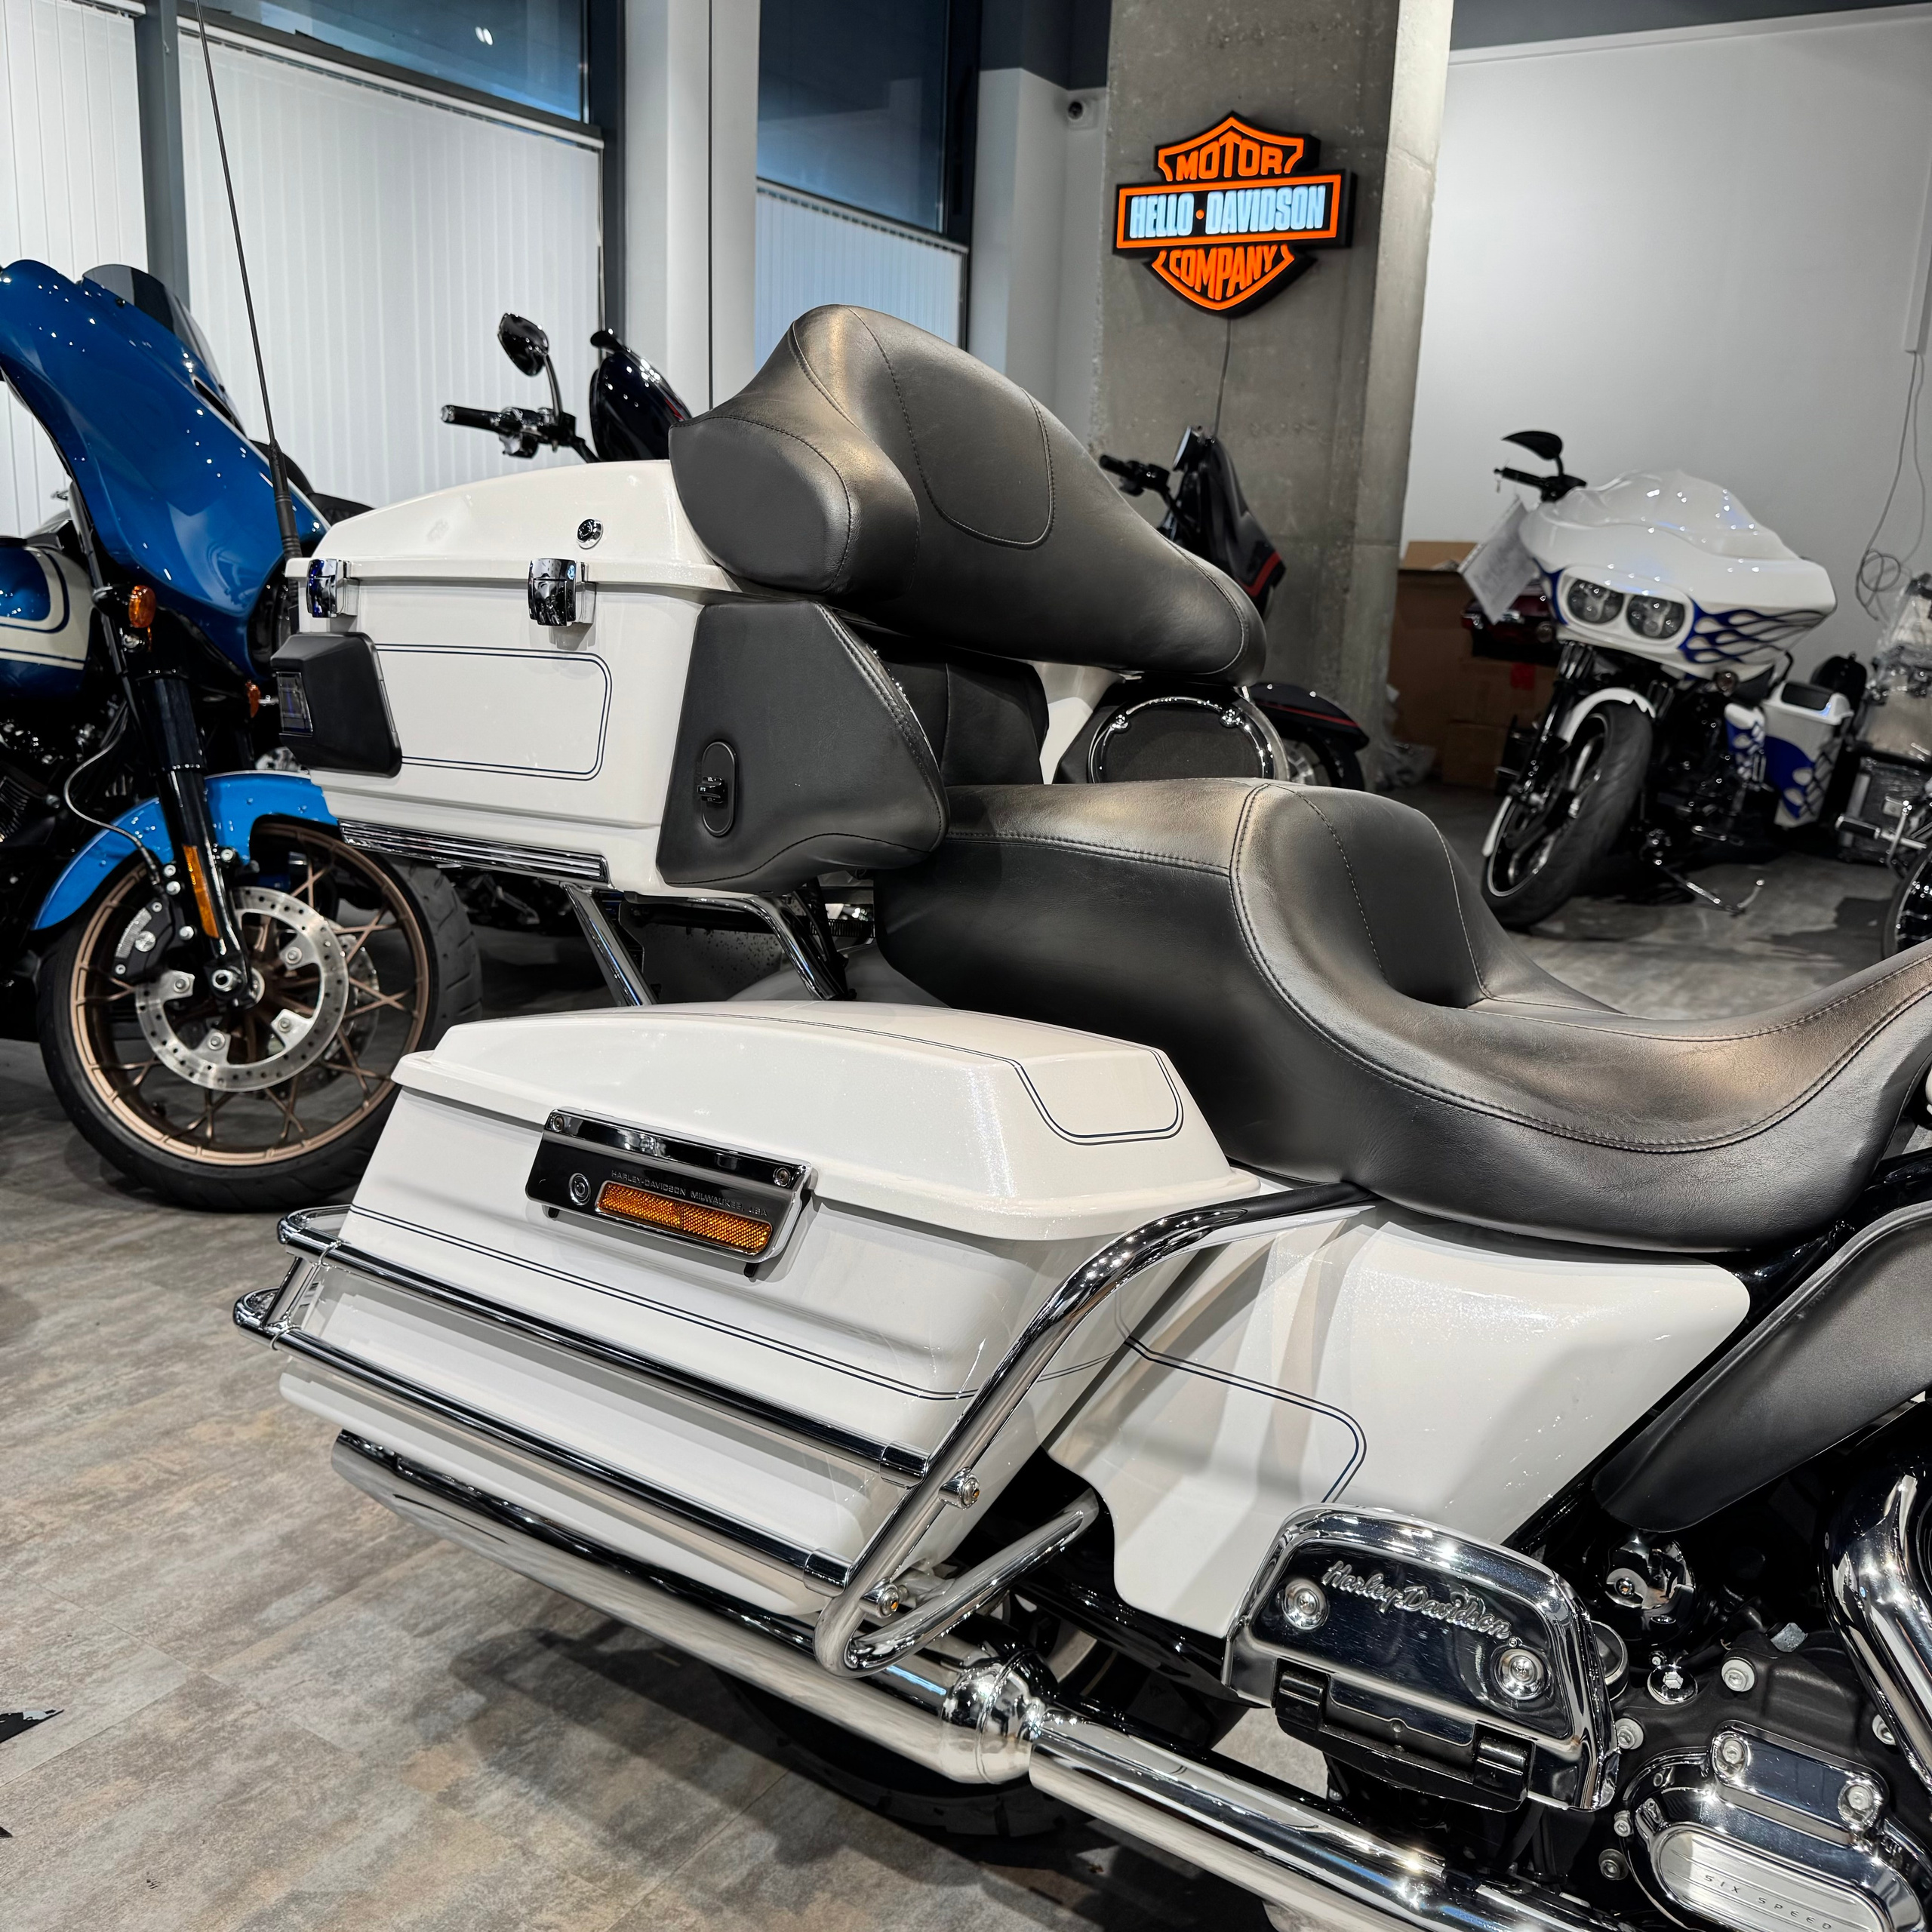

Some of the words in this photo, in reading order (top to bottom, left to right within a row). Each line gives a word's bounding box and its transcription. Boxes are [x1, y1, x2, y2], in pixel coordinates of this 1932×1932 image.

[1176, 130, 1283, 181] MOTOR
[1130, 192, 1195, 238] HELLO
[1205, 185, 1326, 235] DAVIDSON
[1170, 245, 1278, 301] COMPANY
[611, 1170, 687, 1196] HARLEY-DAVIDSON
[1704, 1875, 1742, 1894] SIX
[1758, 1897, 1832, 1930] SPEED
